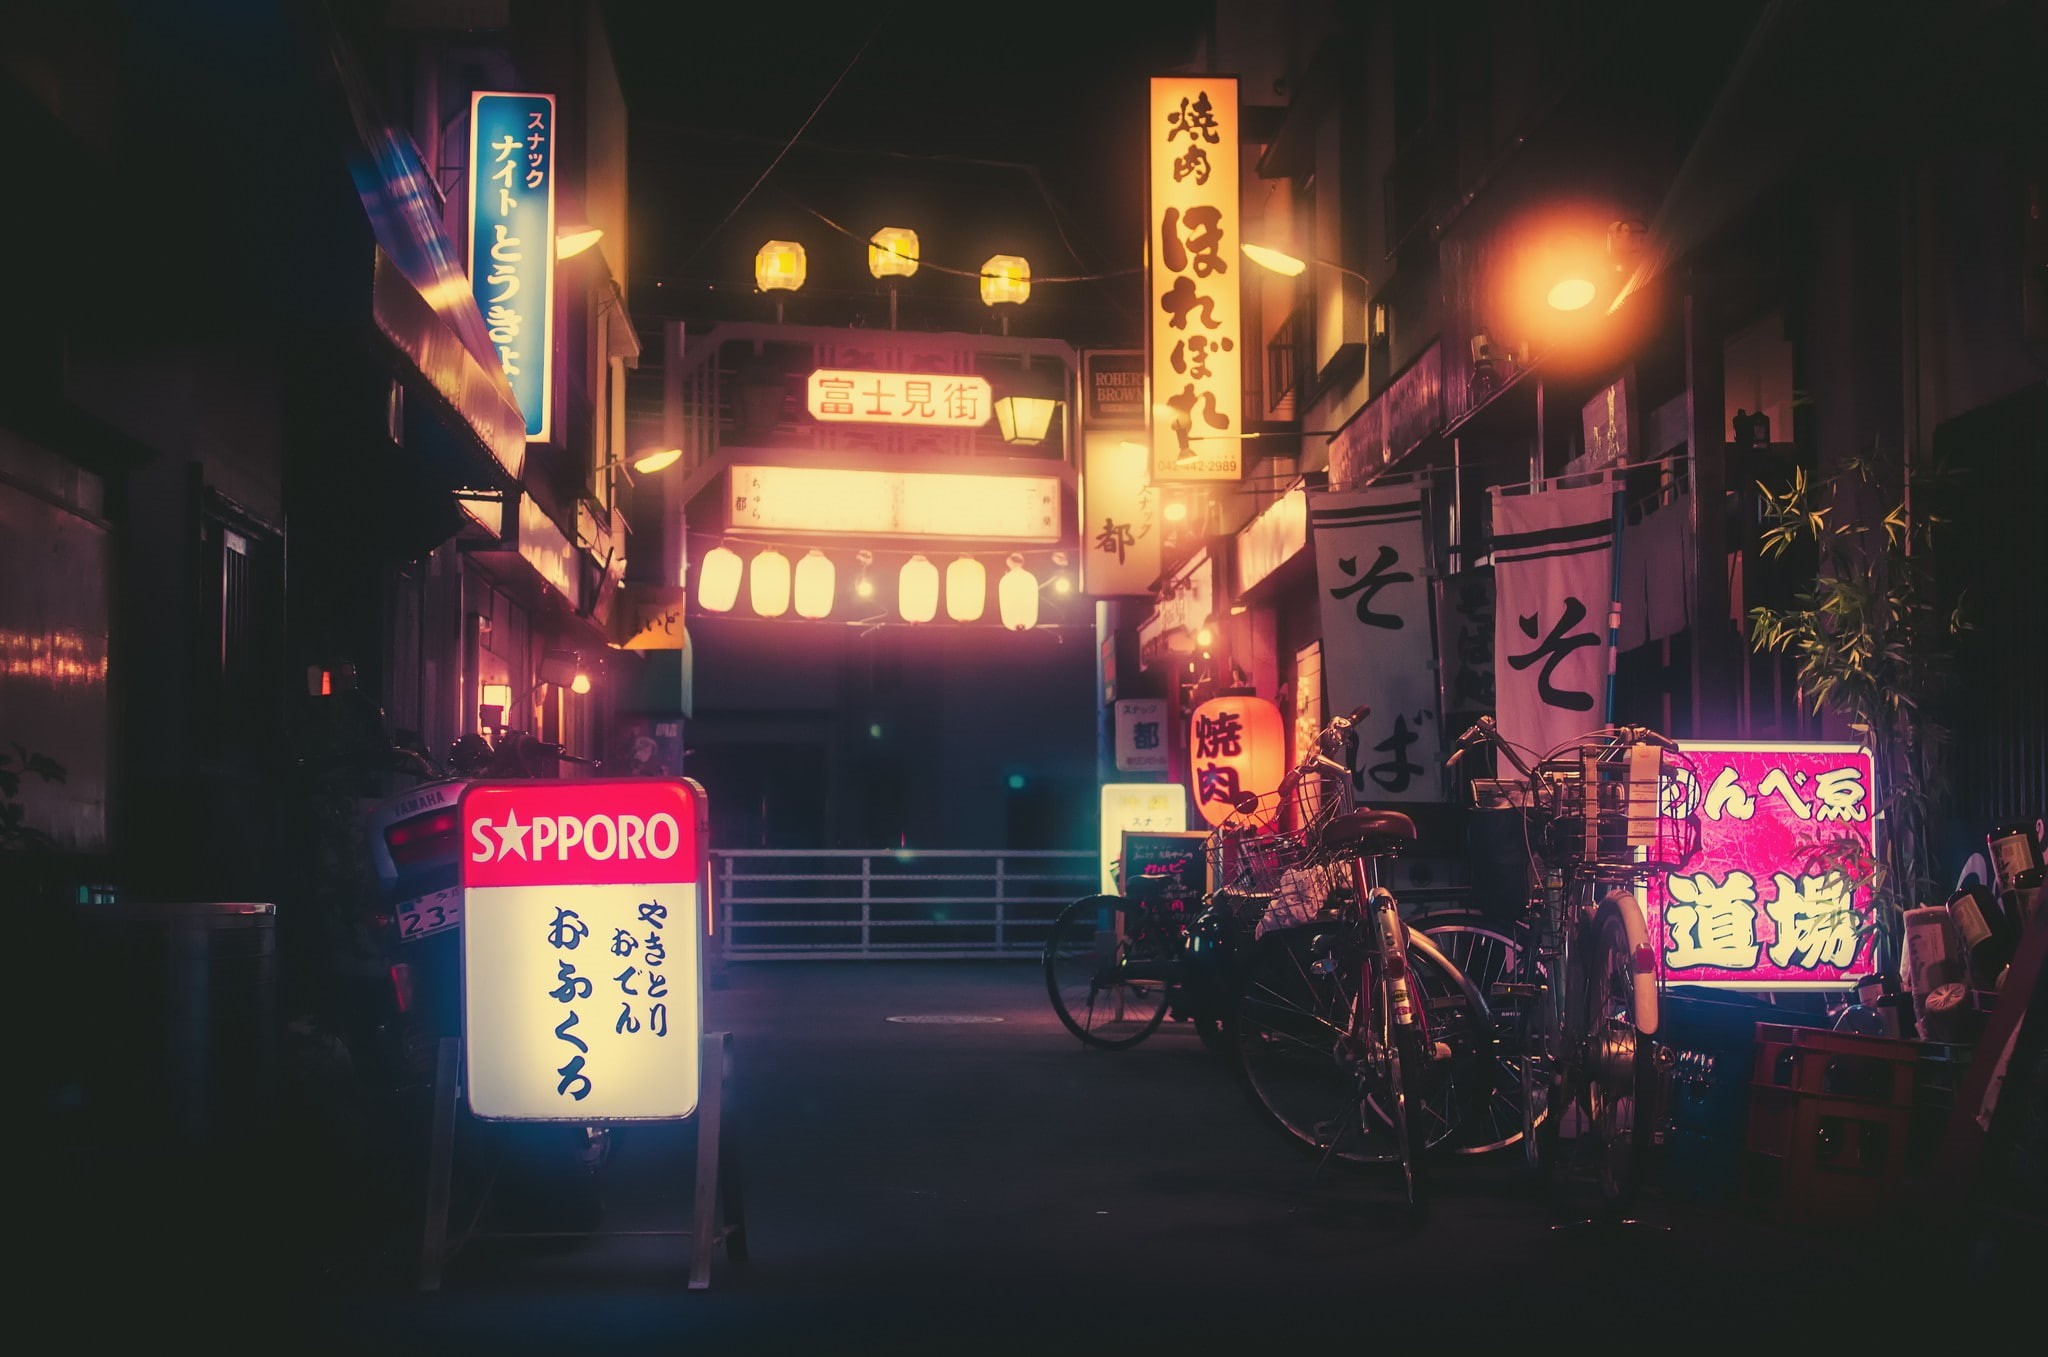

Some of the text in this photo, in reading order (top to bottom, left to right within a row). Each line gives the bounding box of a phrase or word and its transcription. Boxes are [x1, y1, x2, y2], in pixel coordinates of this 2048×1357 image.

[525, 112, 546, 189] スナック
[1161, 205, 1234, 442] ほれぼれ
[819, 377, 979, 420] 富士見街
[1095, 517, 1136, 566] 都
[1329, 545, 1434, 793] そば
[1507, 596, 1602, 712] そ
[1133, 721, 1160, 750] 都
[1196, 711, 1244, 806] 焼肉
[394, 791, 445, 817] YAMAHA
[637, 899, 669, 1038] やきとり
[1664, 868, 1862, 970] 道場
[547, 906, 593, 1101] おふくろ
[610, 927, 643, 1035] おでん
